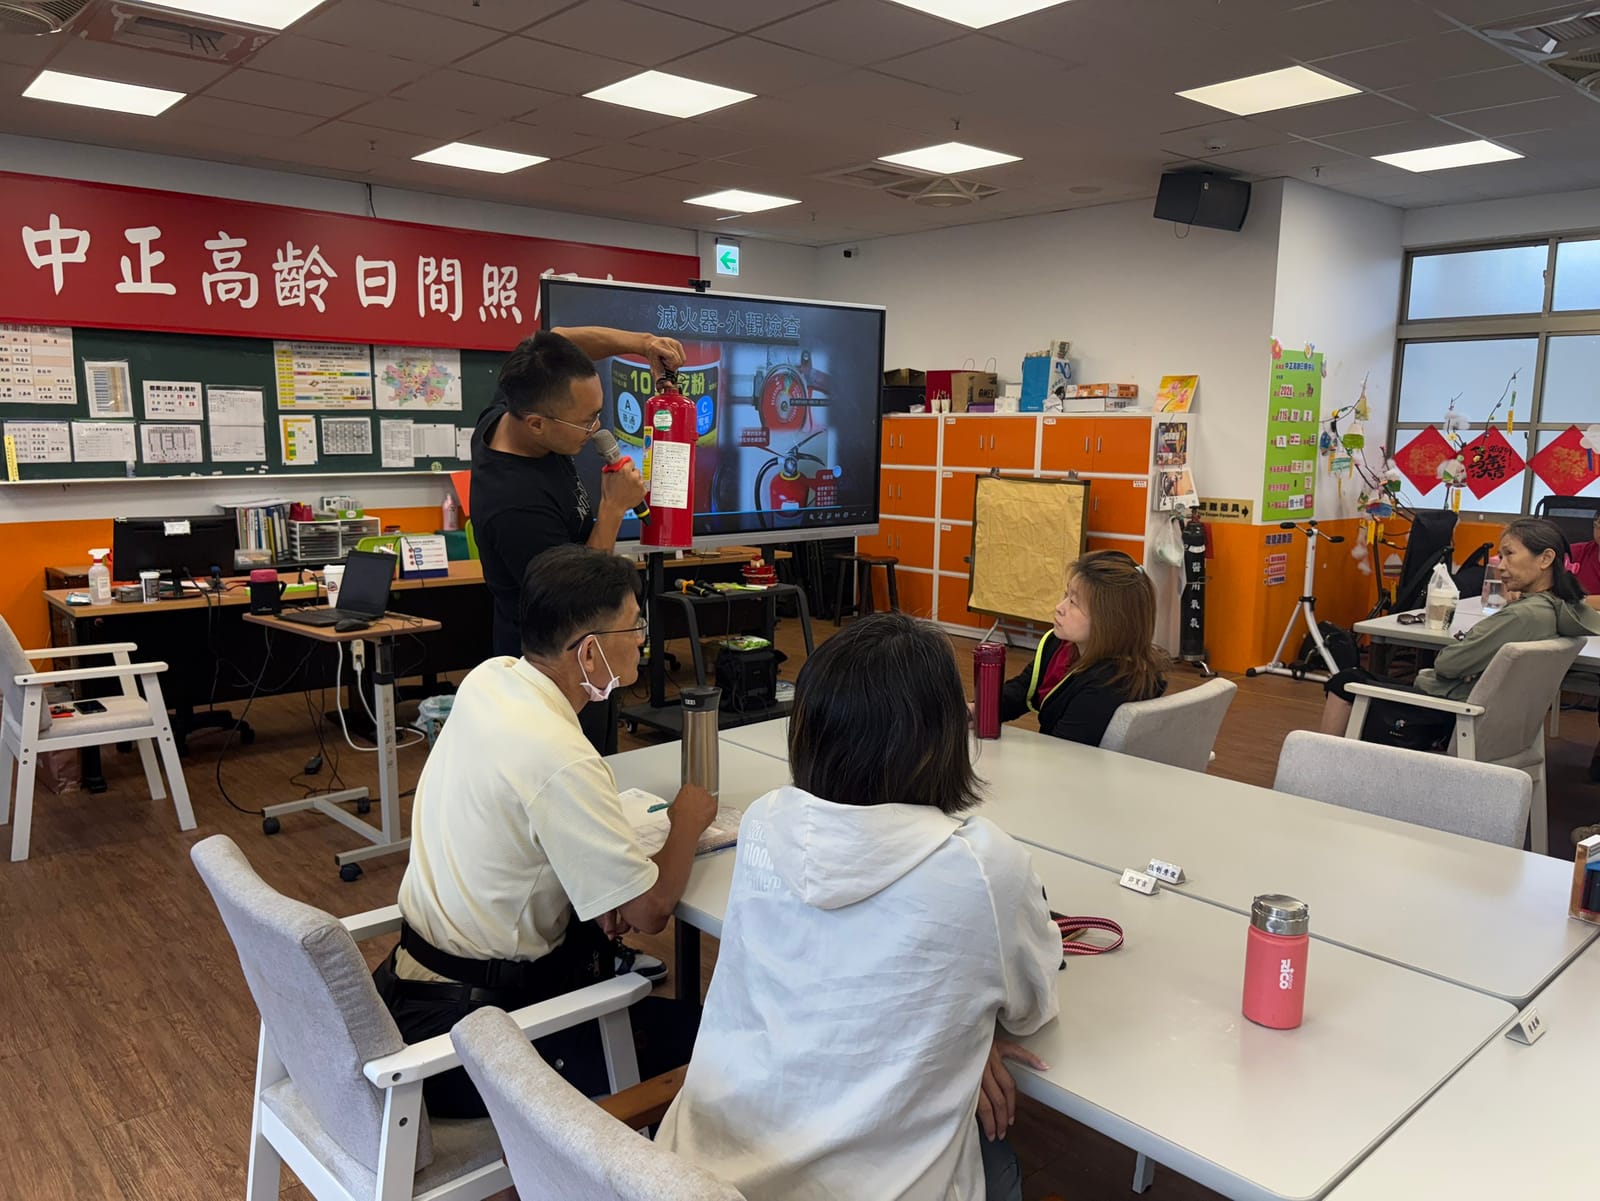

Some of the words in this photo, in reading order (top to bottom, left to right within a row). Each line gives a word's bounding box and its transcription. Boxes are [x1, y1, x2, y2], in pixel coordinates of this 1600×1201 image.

[22, 213, 613, 324] 中正高齡日間照
[657, 304, 801, 338] 滅火器-外觀檢查
[624, 399, 631, 411] A
[702, 402, 708, 413] C
